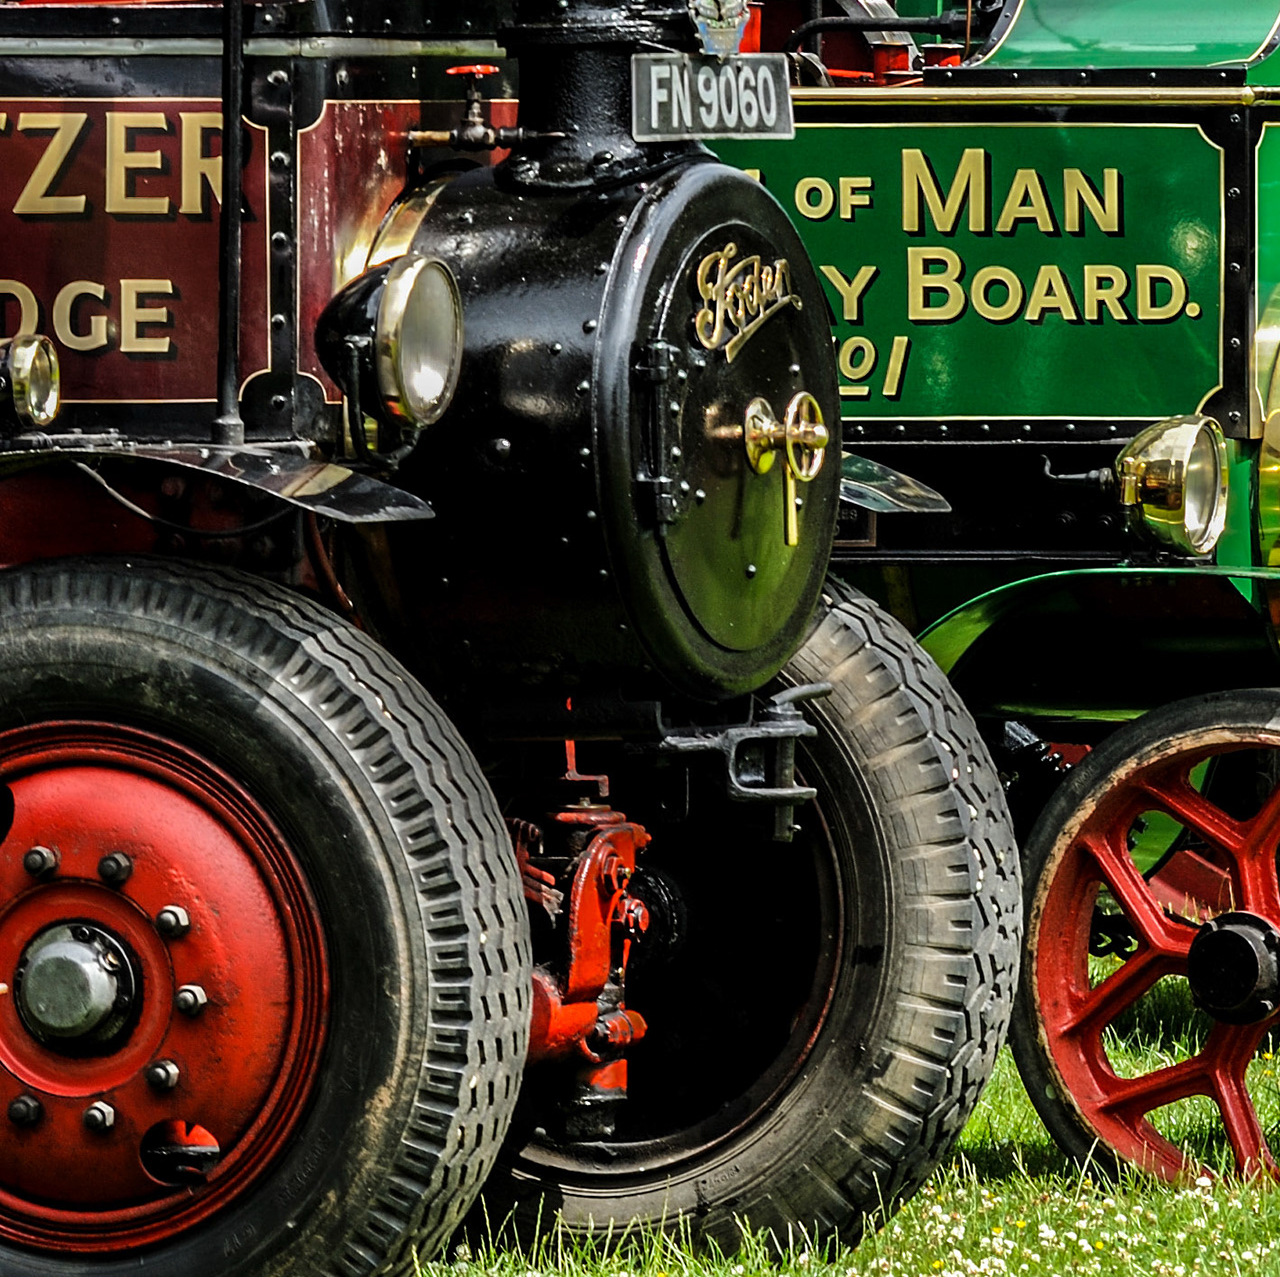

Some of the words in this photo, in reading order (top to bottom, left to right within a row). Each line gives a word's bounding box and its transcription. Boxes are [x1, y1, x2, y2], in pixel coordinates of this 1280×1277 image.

[650, 64, 692, 129] FN
[697, 64, 778, 129] 9060
[0, 111, 224, 215] ZER
[696, 242, 803, 363] Foden
